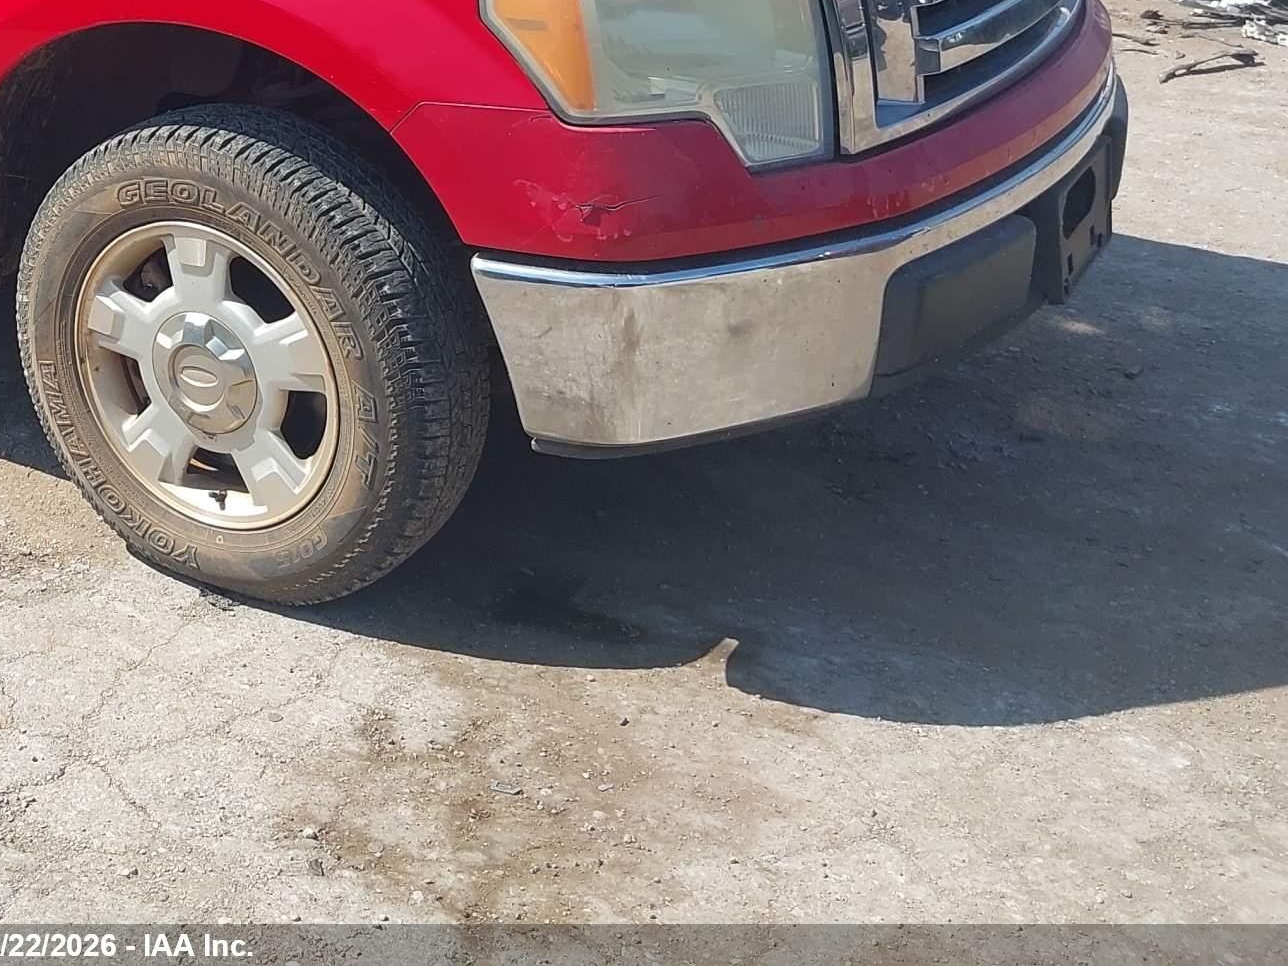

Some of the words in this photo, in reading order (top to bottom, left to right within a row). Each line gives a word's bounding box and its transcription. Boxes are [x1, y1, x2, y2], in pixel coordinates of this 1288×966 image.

[37, 359, 202, 571] YOKOHAMA
[117, 178, 364, 362] GEOLANDAR
[353, 382, 380, 491] A/T
